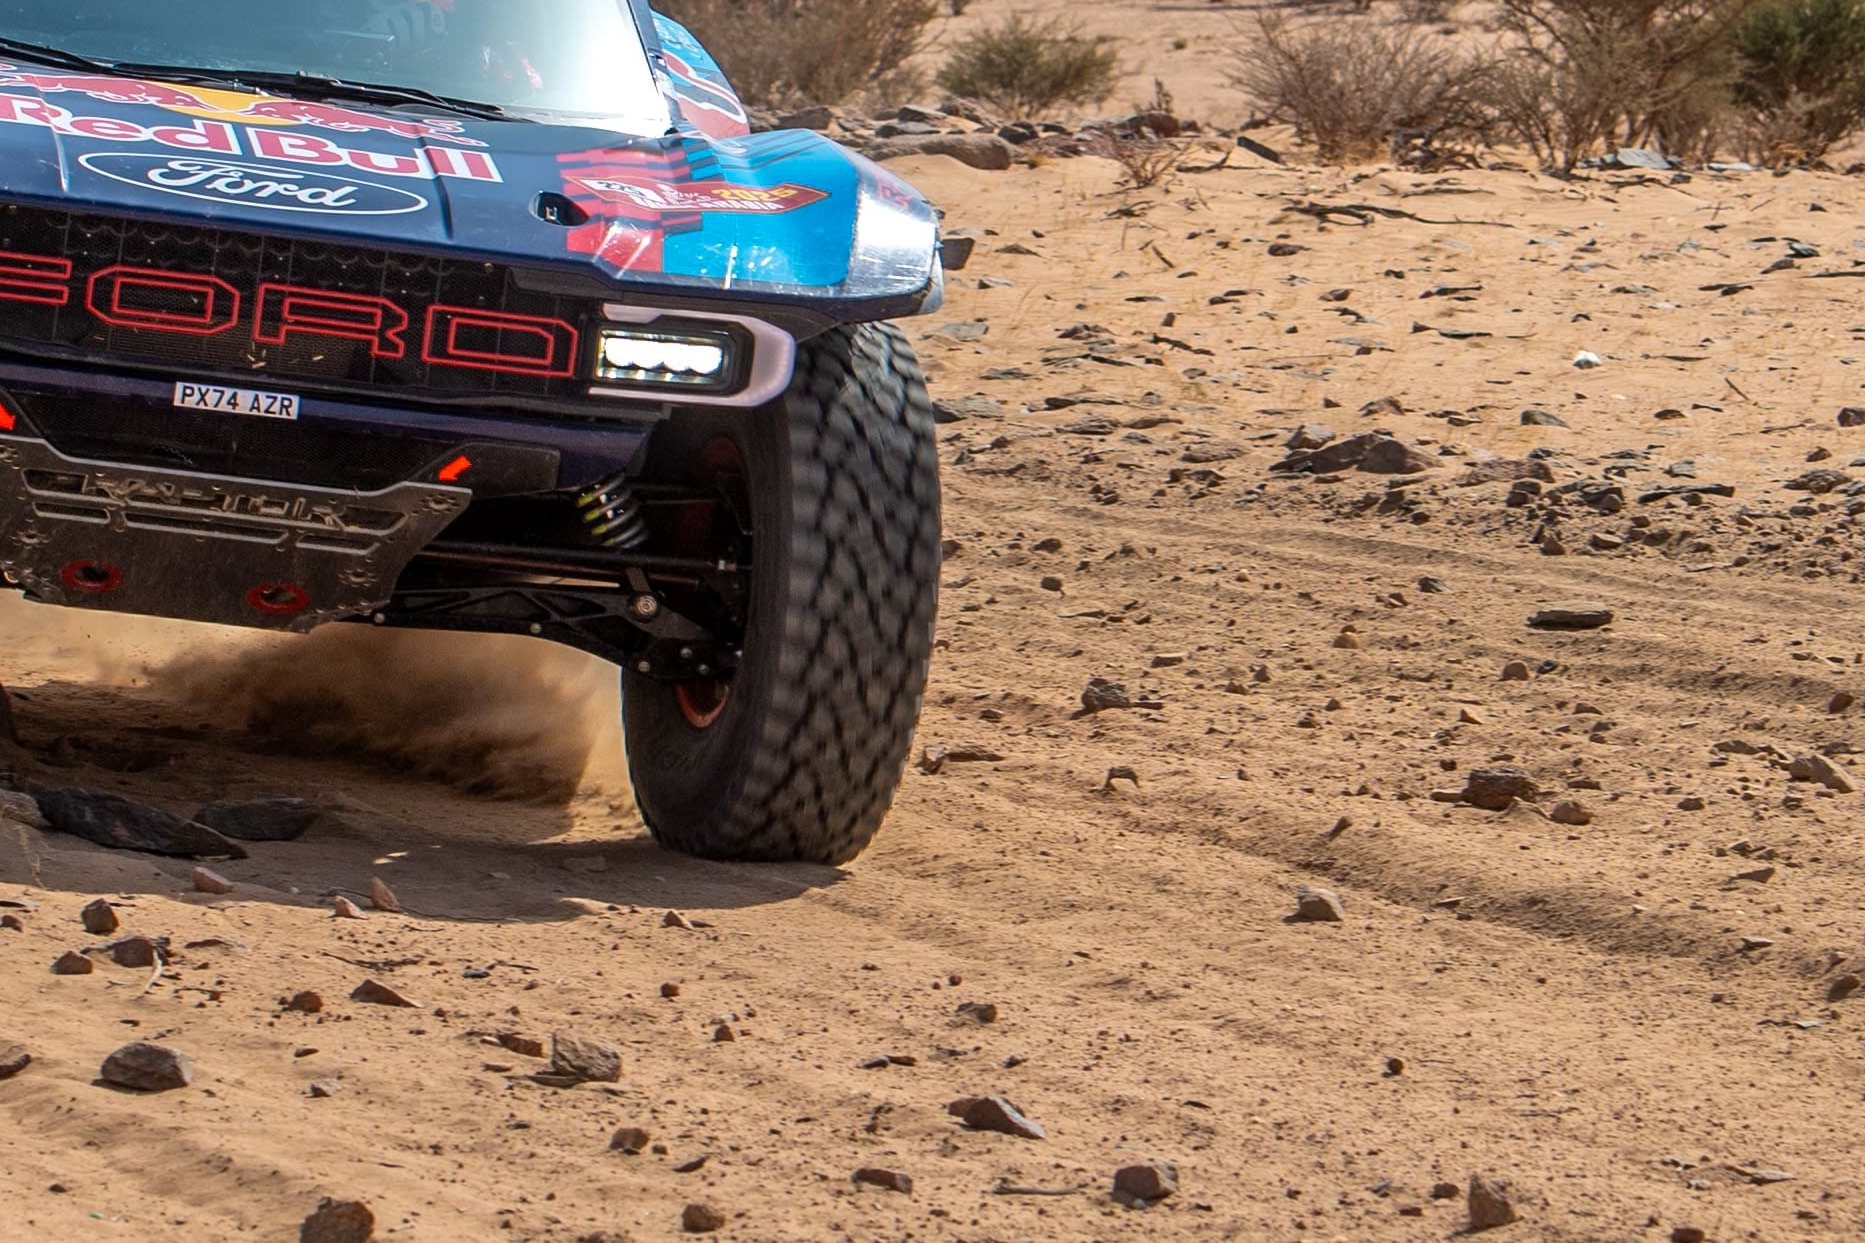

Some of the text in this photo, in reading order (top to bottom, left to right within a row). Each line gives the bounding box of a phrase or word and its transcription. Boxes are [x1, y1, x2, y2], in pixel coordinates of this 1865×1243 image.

[245, 128, 504, 183] Bull
[147, 158, 358, 207] Ford
[711, 187, 799, 202] 2025
[180, 385, 293, 417] PX74 AZR
